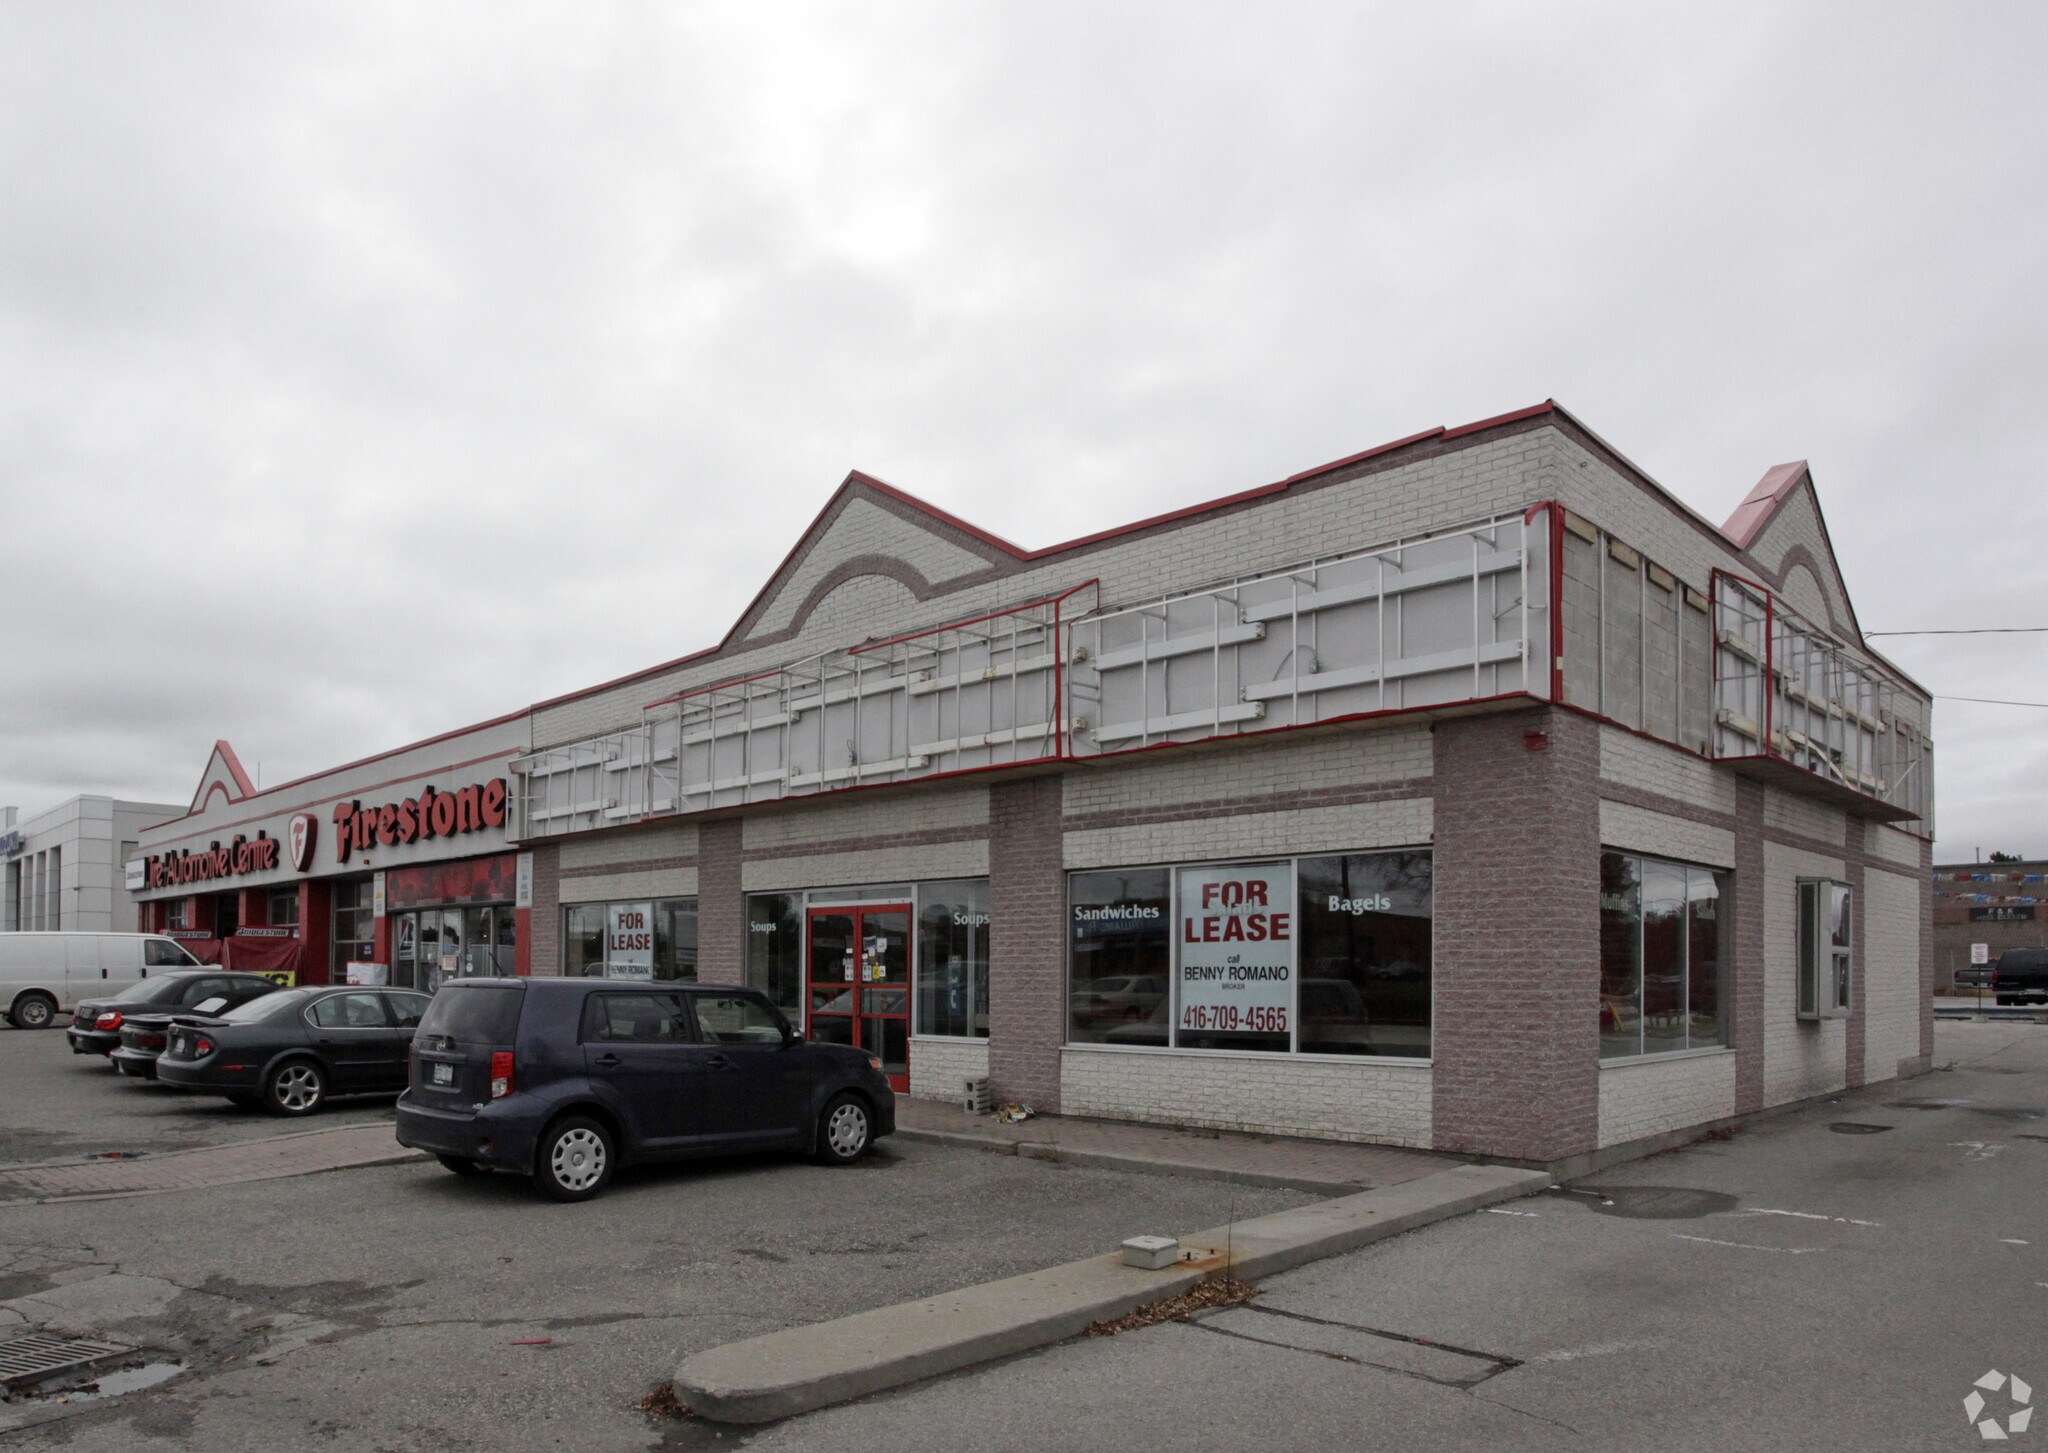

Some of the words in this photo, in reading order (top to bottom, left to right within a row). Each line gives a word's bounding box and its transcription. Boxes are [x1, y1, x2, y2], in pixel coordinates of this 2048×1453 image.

[333, 778, 506, 864] Firestone
[230, 830, 278, 876] Centre
[1202, 880, 1268, 909] FOR
[1075, 904, 1160, 920] Sandwiches
[1328, 893, 1391, 915] Bagels
[618, 912, 644, 930] FOR
[750, 920, 777, 935] Soups
[953, 911, 990, 928] Soups
[1185, 913, 1290, 943] LEASE
[611, 933, 651, 951] LEASE
[1227, 954, 1241, 964] call
[1184, 966, 1225, 980] BENNY
[1228, 965, 1289, 981] ROMANO
[1221, 982, 1246, 990] BROKER
[1183, 1005, 1287, 1032] 416-709-4565
